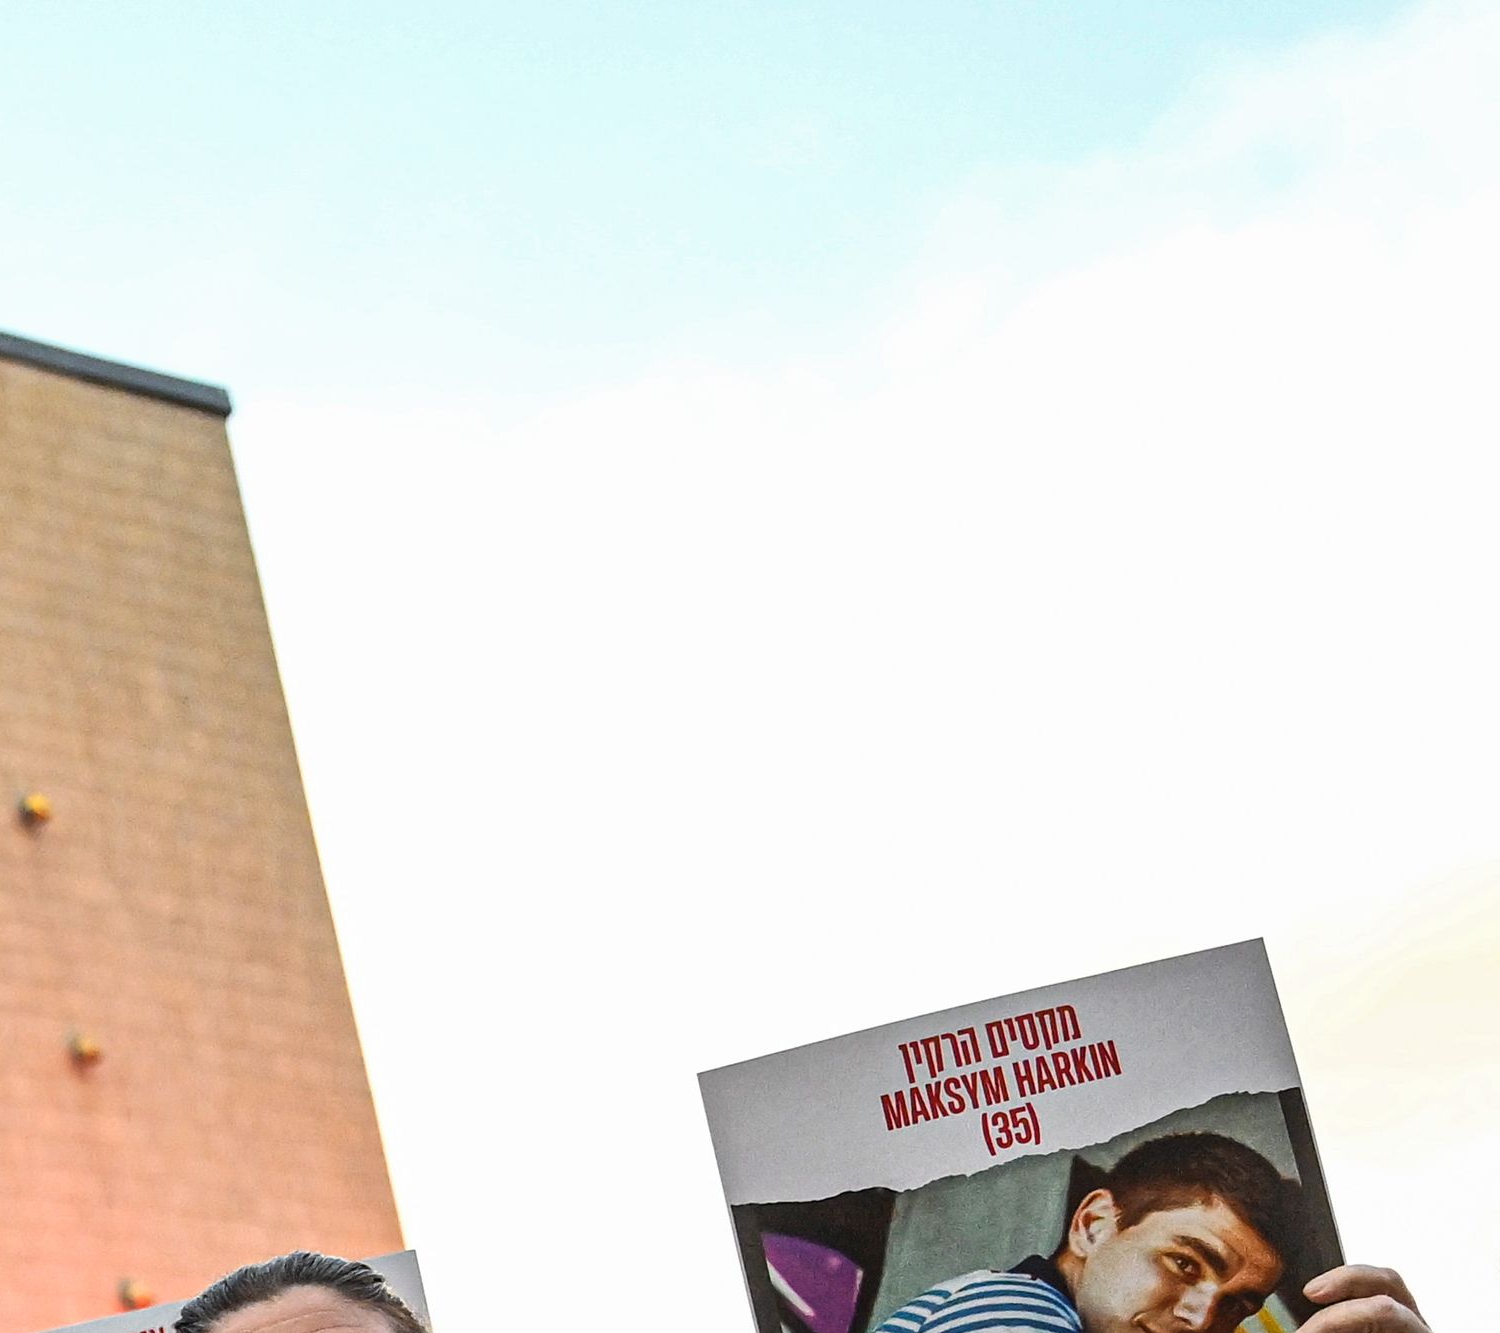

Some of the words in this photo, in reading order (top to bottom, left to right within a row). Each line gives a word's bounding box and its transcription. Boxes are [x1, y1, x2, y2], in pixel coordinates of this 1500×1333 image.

[898, 1026, 982, 1084] הרקין
[985, 1004, 1082, 1059] מקסים
[880, 1066, 1011, 1131] MAKSYM
[1012, 1039, 1122, 1098] HARKIN
[981, 1102, 1040, 1156] (35)
